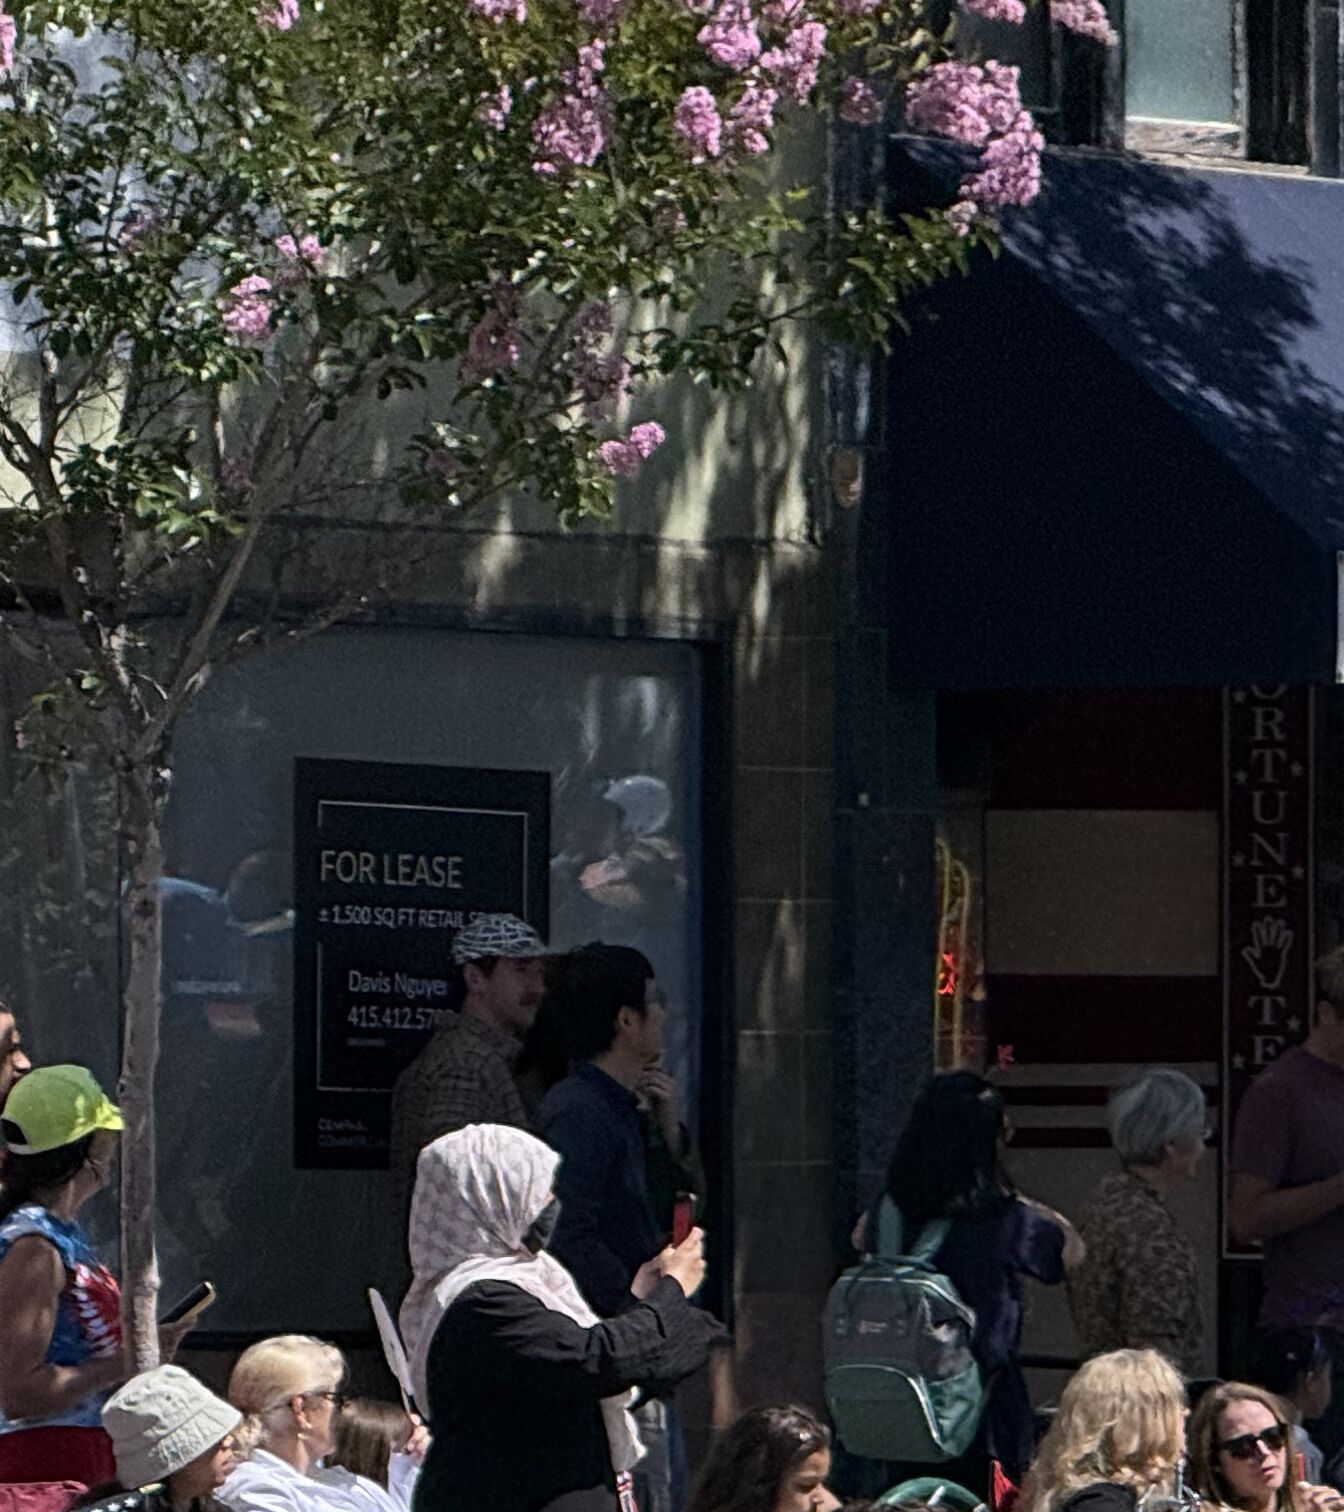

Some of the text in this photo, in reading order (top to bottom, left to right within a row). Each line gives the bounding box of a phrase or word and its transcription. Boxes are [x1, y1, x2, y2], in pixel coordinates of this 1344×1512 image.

[1250, 684, 1288, 908] RTUNE
[319, 849, 463, 889] FOR LEASE
[374, 907, 396, 928] SQ
[397, 908, 418, 926] FT
[419, 909, 464, 929] RETAIL
[348, 969, 391, 994] Davis
